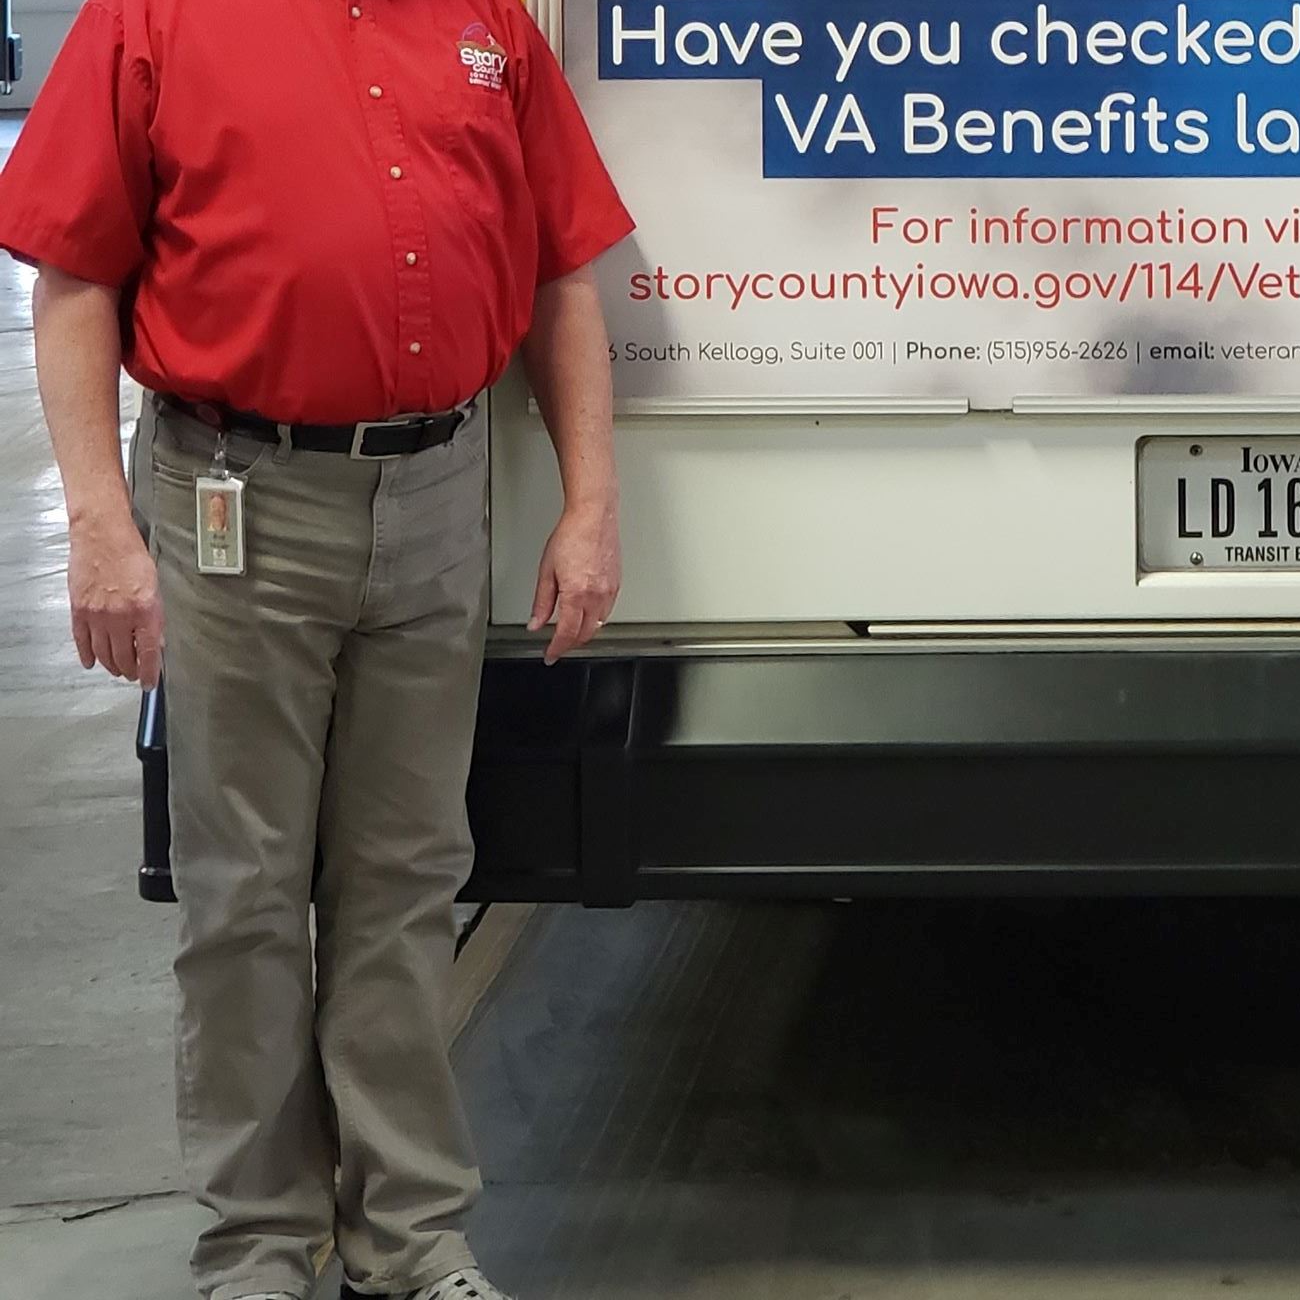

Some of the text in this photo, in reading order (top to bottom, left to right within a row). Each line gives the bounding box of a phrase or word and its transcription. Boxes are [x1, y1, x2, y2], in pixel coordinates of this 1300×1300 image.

[460, 47, 508, 74] Story
[612, 4, 803, 66] Have
[826, 21, 960, 83] you
[774, 93, 876, 154] VA
[903, 92, 1209, 154] Benefits
[871, 207, 953, 245] For
[969, 207, 1248, 245] information
[624, 342, 691, 362] South
[698, 342, 784, 365] Kellogg,
[790, 341, 846, 361] Suite
[852, 341, 884, 360] 001
[906, 341, 981, 361] Phone:
[986, 341, 1129, 365] (515)956-2626
[1149, 340, 1215, 360] email:
[1177, 478, 1236, 538] LD
[1224, 546, 1290, 562] TRANSIT
